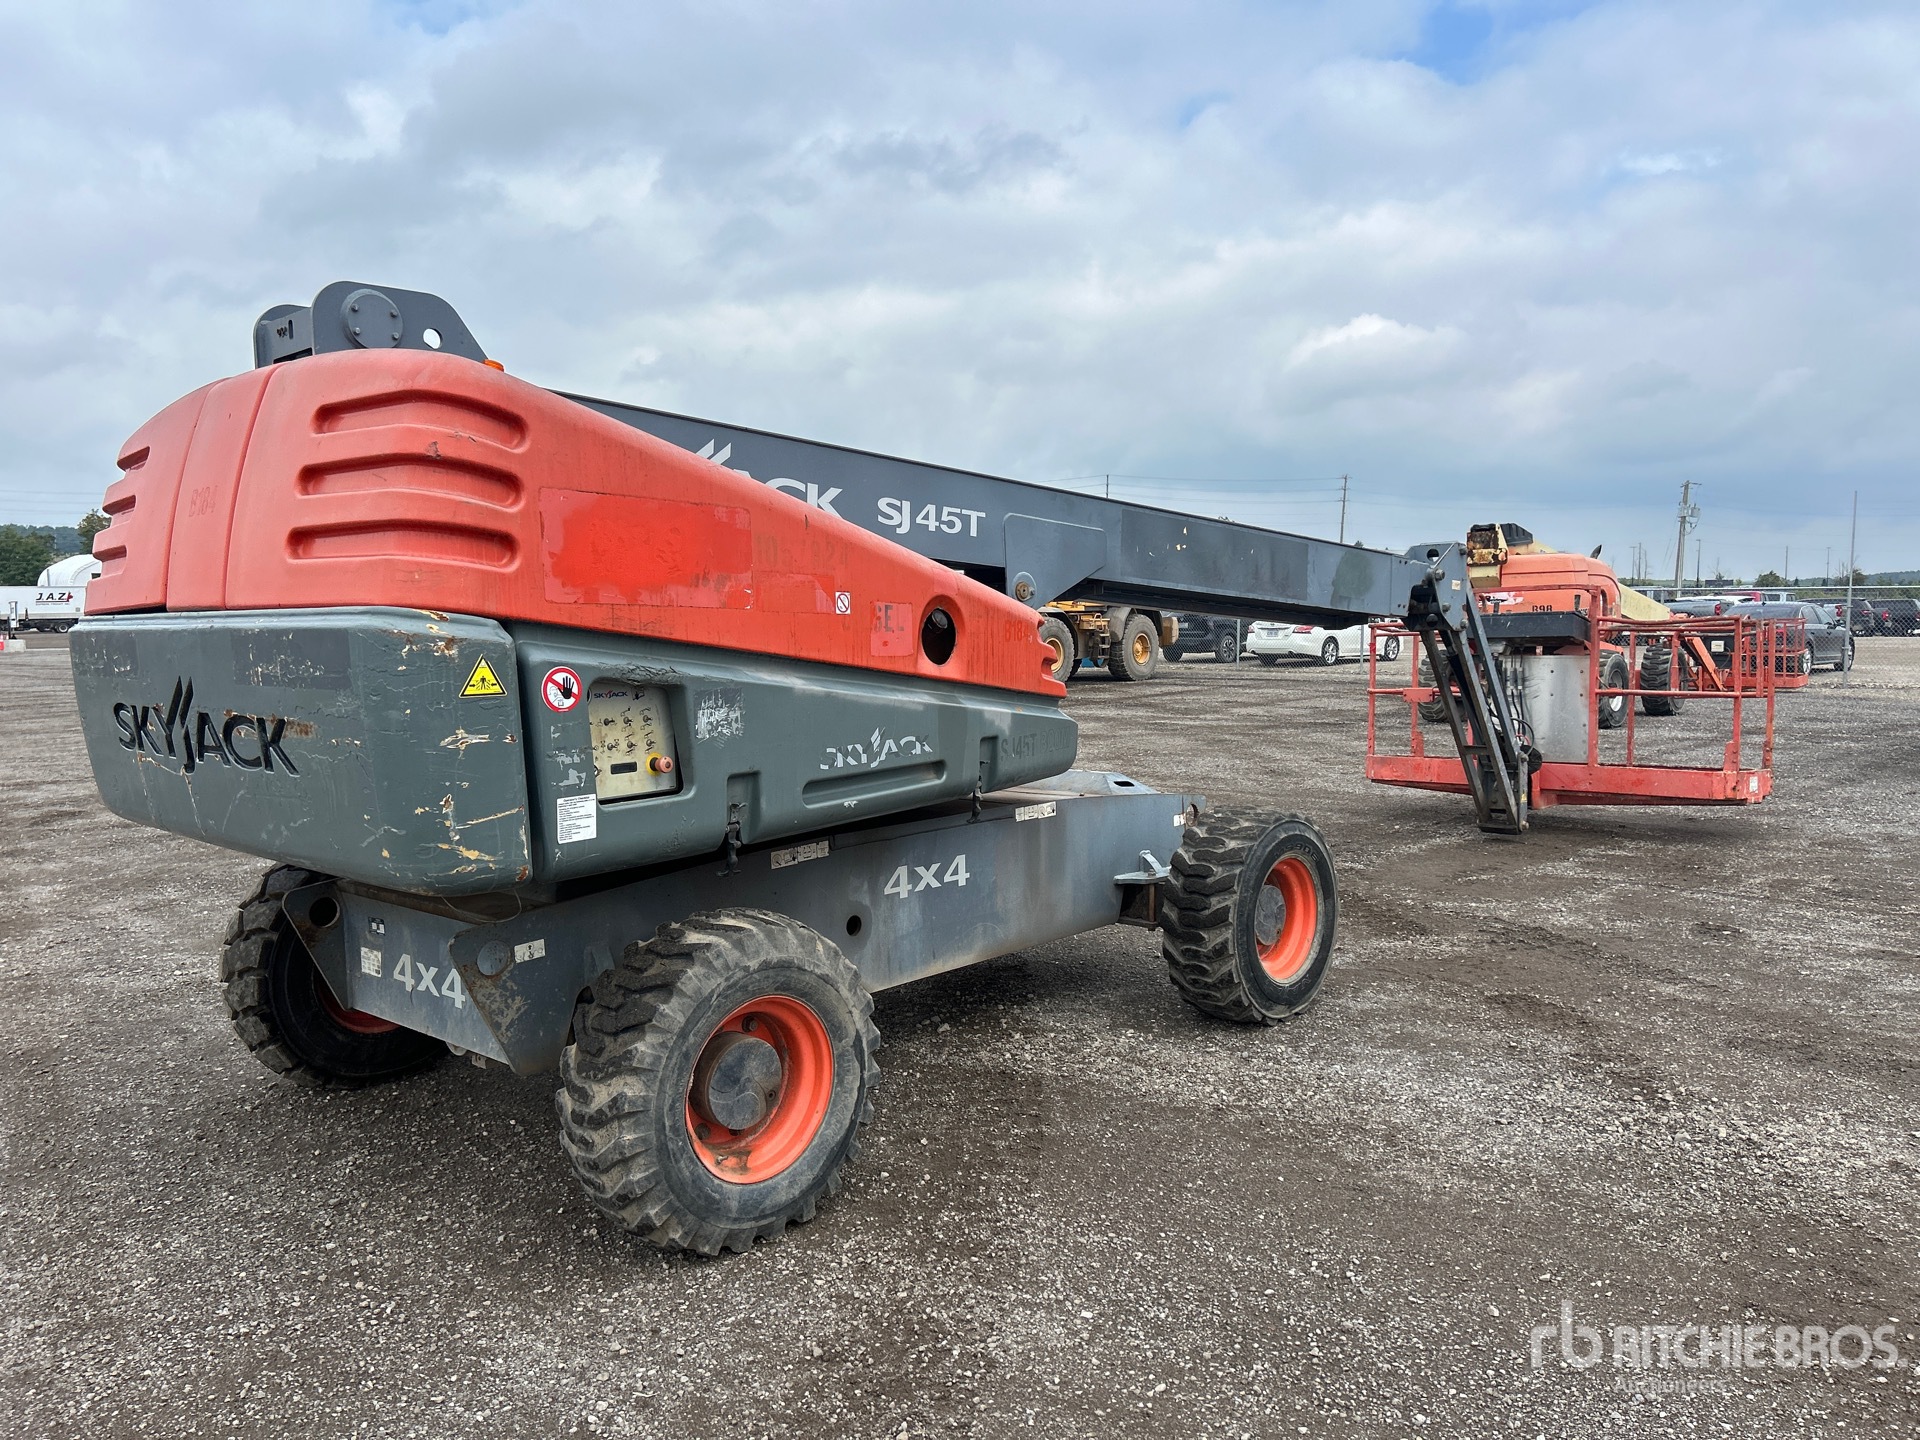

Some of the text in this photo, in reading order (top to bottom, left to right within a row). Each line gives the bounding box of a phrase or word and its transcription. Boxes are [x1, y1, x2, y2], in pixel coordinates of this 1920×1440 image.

[877, 497, 986, 538] SJ45T
[594, 690, 628, 699] SKYJACK
[113, 676, 300, 776] SKYJACK
[884, 854, 970, 899] 4x4
[393, 953, 466, 1009] 4x4
